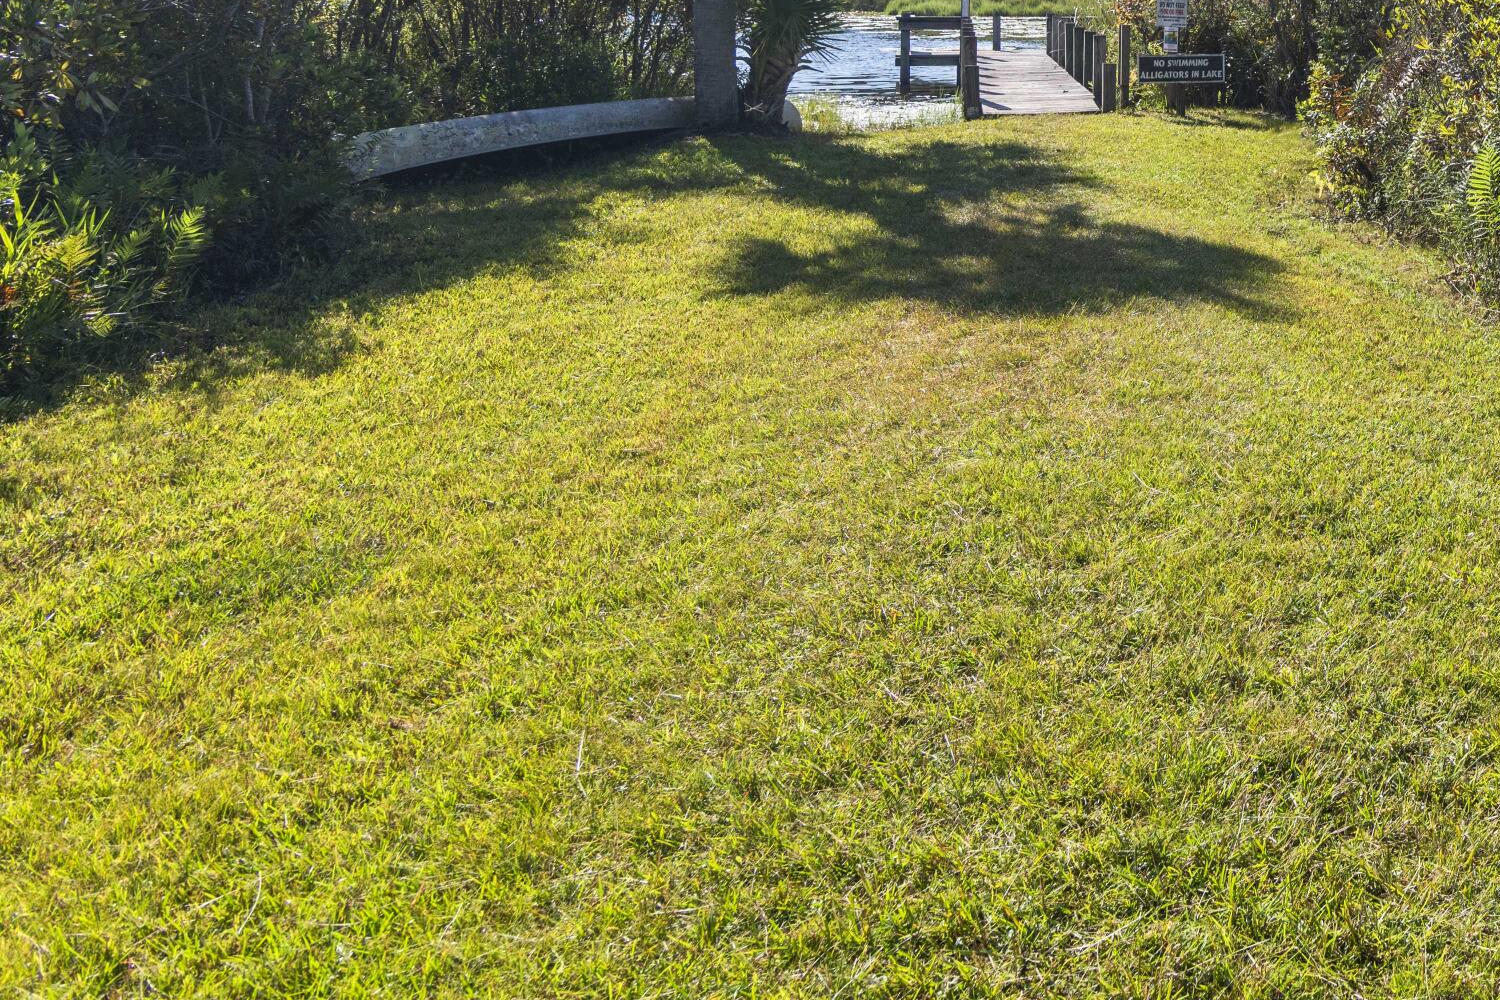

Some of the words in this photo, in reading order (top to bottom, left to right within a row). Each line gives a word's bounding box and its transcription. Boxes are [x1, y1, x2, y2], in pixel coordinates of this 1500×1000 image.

[1153, 59, 1165, 67] NO
[1167, 58, 1209, 67] SWIMMING
[1140, 71, 1189, 79] ALLIGATORS
[1191, 70, 1200, 78] IN
[1202, 70, 1222, 78] LAKE
